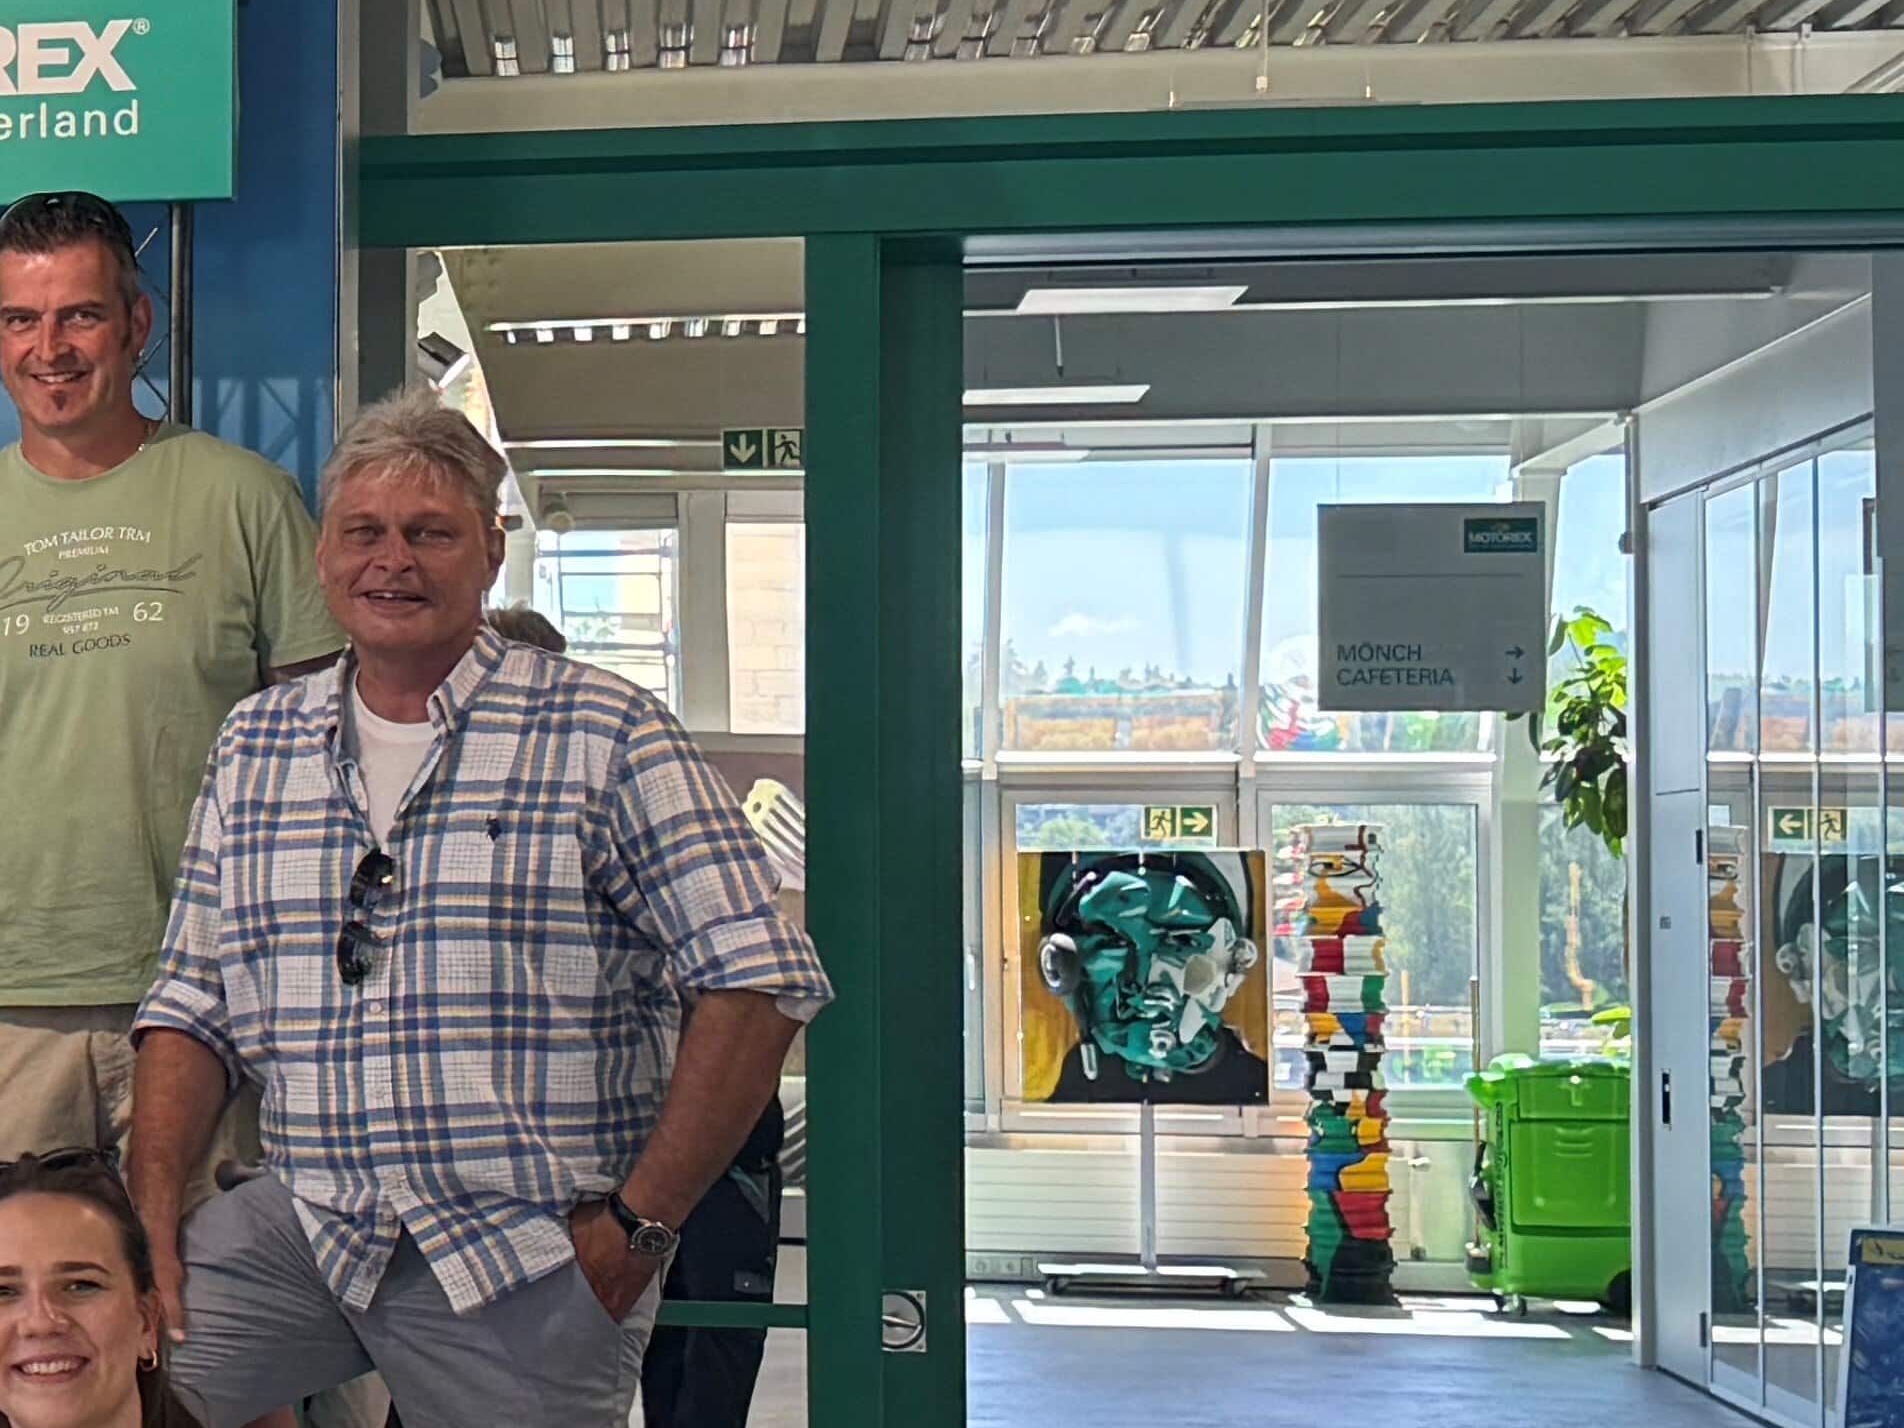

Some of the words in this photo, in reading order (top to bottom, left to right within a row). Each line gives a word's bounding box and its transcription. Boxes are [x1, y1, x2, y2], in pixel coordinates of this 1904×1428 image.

[24, 535, 59, 555] TOM
[59, 526, 113, 545] TAILOR
[58, 545, 110, 560] PREMIUM
[132, 602, 164, 623] 62
[2, 614, 30, 637] 19
[29, 639, 67, 658] REAL
[72, 634, 131, 654] GOODS
[1336, 639, 1422, 663] MÖNCH
[1336, 667, 1455, 688] CAFETERIA
